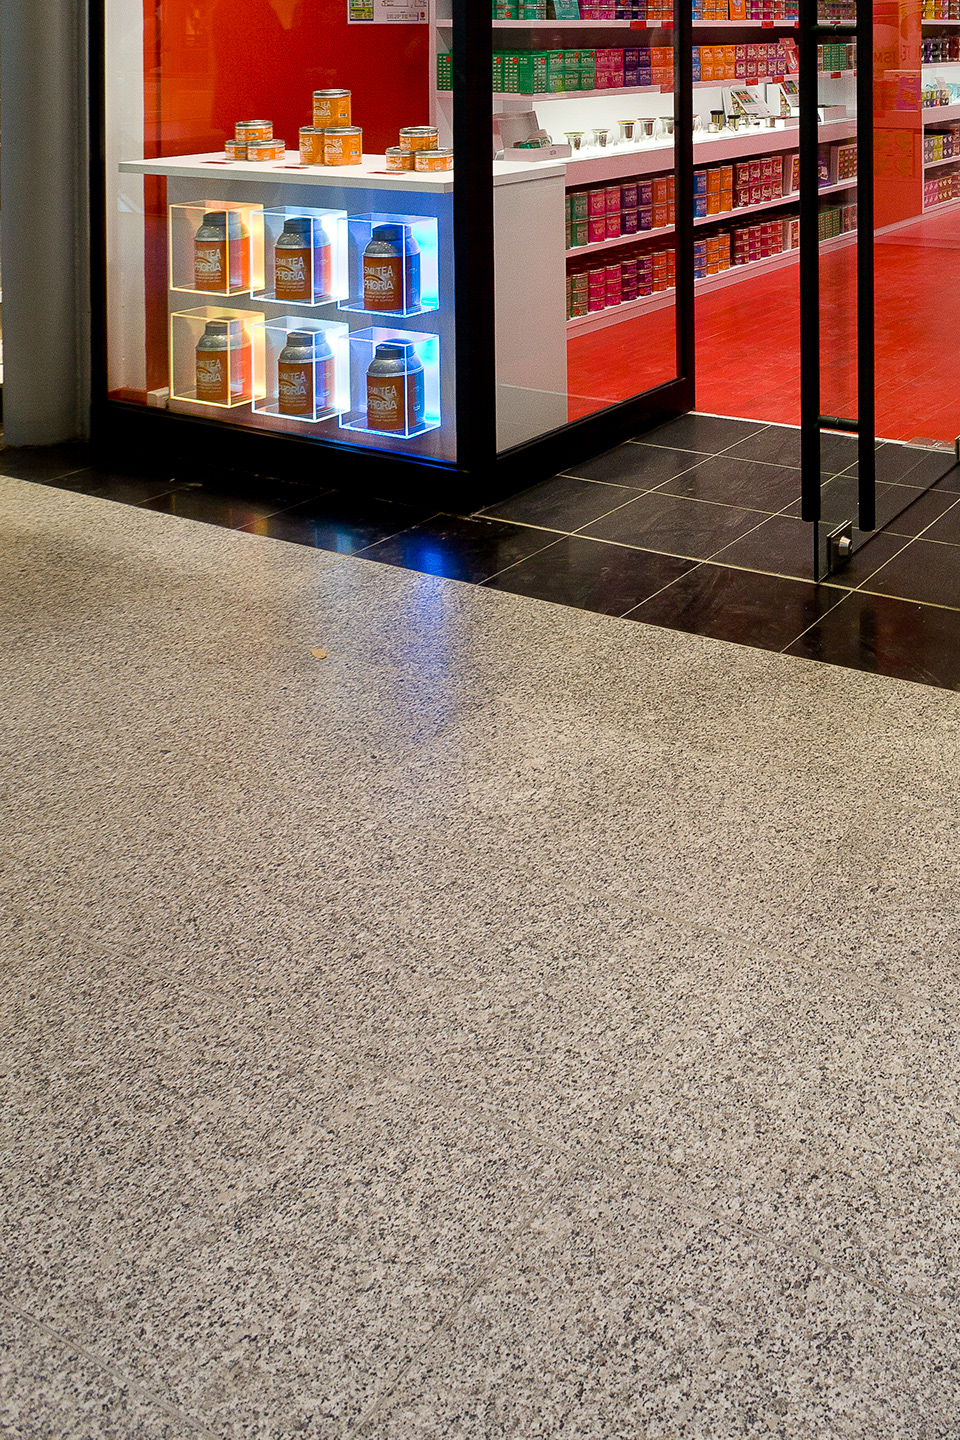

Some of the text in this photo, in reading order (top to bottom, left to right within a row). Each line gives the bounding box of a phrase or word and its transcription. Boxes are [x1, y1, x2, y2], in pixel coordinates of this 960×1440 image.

[206, 248, 221, 260] TEA
[288, 256, 305, 268] TEA
[377, 265, 394, 277] TEA
[289, 371, 306, 383] TEA
[380, 385, 397, 397] TEA
